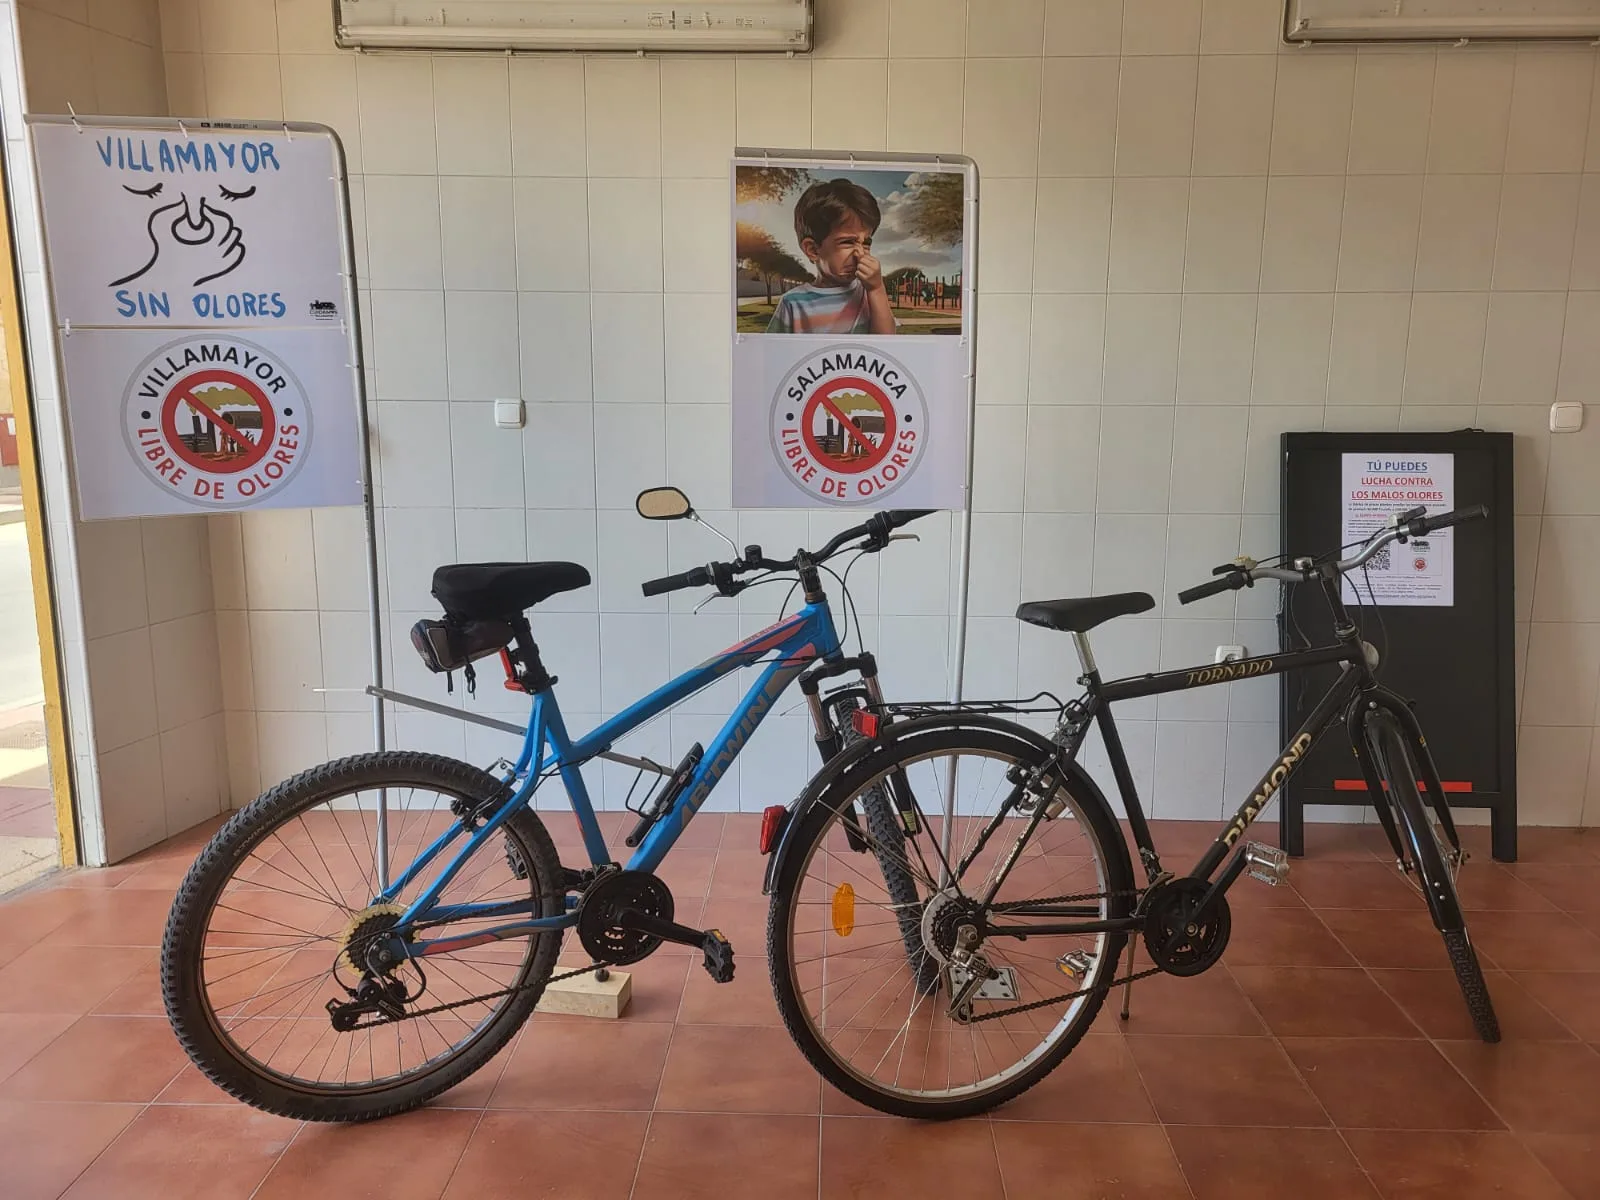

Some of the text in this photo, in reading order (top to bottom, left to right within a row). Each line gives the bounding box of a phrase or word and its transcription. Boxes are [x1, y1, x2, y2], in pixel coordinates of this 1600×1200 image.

[96, 135, 281, 174] VILLAMAYOR
[115, 289, 287, 319] SIN OLORES
[138, 343, 287, 400] VILLAMAYOR
[787, 353, 908, 402] SALAMANCA
[137, 423, 300, 500] LIBRE DE OLORES
[781, 428, 917, 498] LIBRE DE OLORES
[1367, 459, 1429, 472] TÚ PUEDES
[1351, 490, 1444, 500] LOS MALOS OLORES
[1361, 477, 1434, 486] LUCHA CONTRA
[1186, 659, 1274, 687] TORNADO
[1224, 732, 1313, 847] DIAMOND
